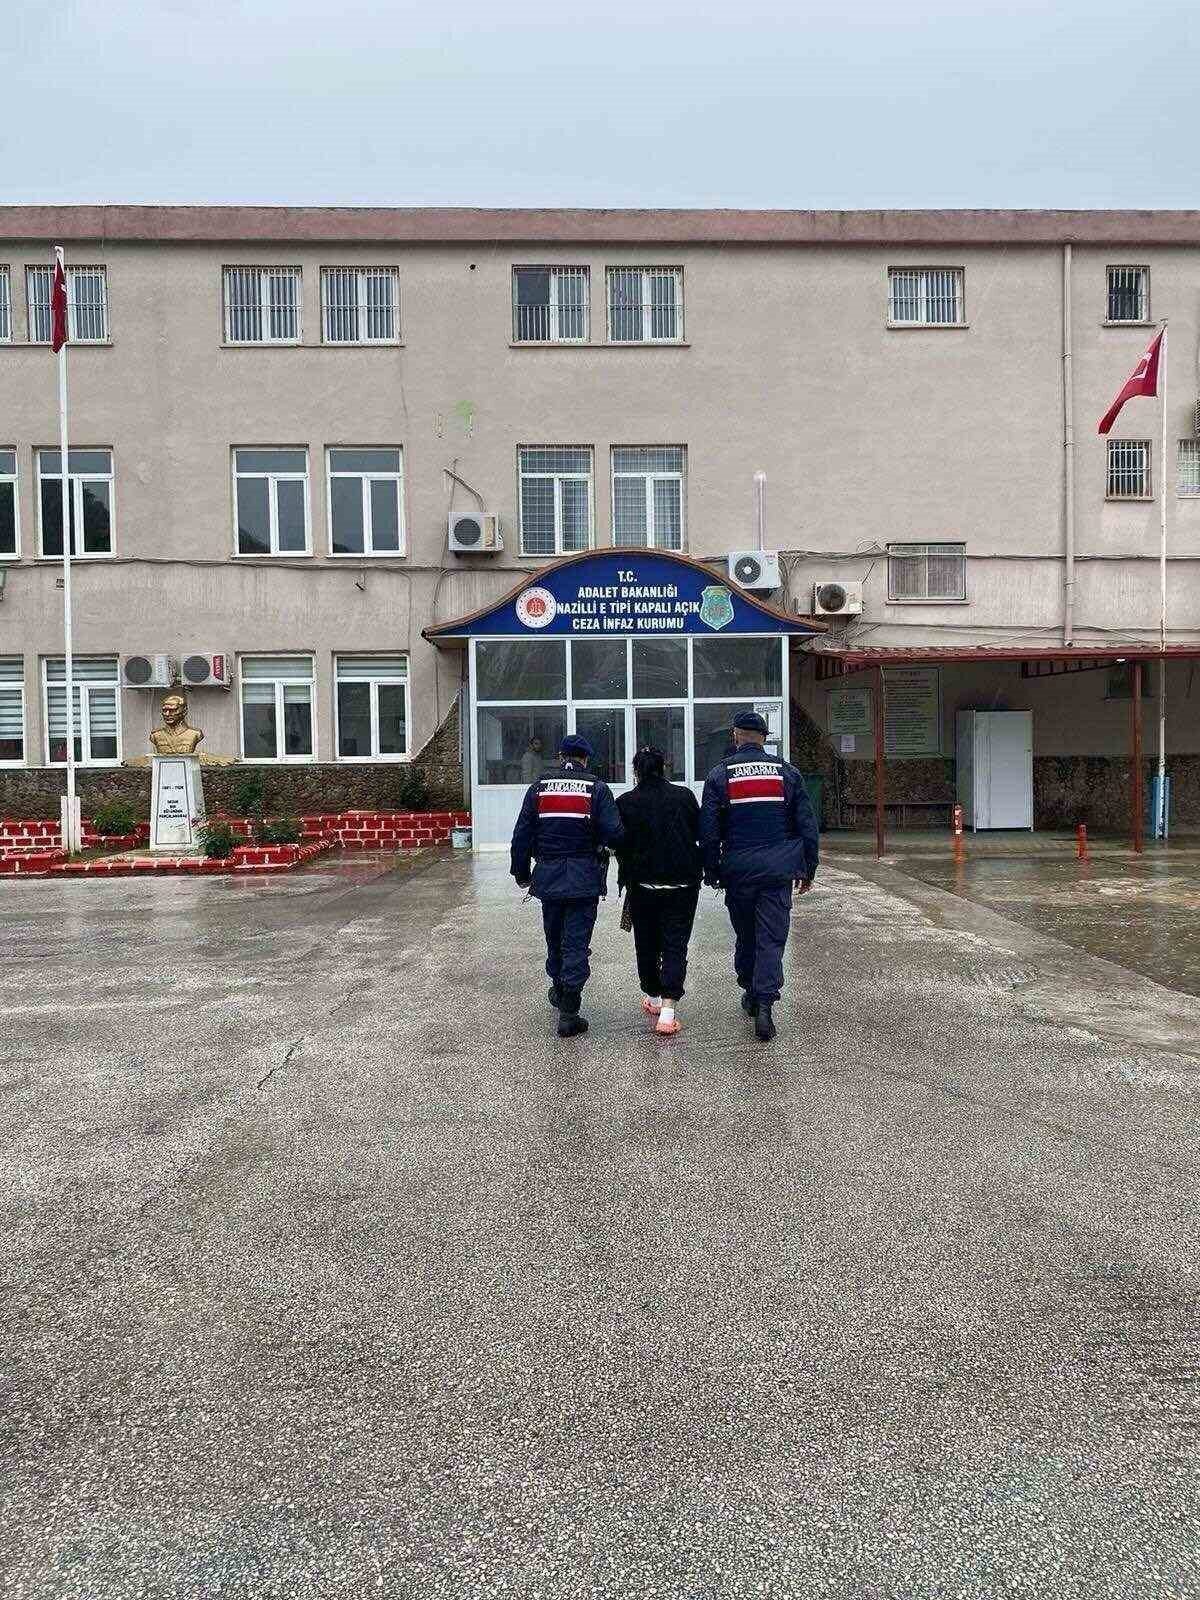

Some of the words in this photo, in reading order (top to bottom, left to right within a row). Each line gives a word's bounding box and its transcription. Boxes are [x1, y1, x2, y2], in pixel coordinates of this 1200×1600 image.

[617, 570, 638, 582] T.C.
[577, 586, 619, 598] ADALET
[621, 585, 678, 598] BAKANLIĞI
[556, 600, 597, 614] NAZİLLİ
[600, 602, 607, 614] E
[609, 600, 631, 614] TİPİ
[634, 602, 673, 614] KAPALI
[675, 602, 700, 616] AÇIK
[572, 618, 600, 630] CEZA
[603, 616, 635, 630] İNFAZ
[637, 618, 684, 630] KURUMU
[733, 765, 779, 777] JANDARMA
[544, 782, 587, 793] JANDARMA
